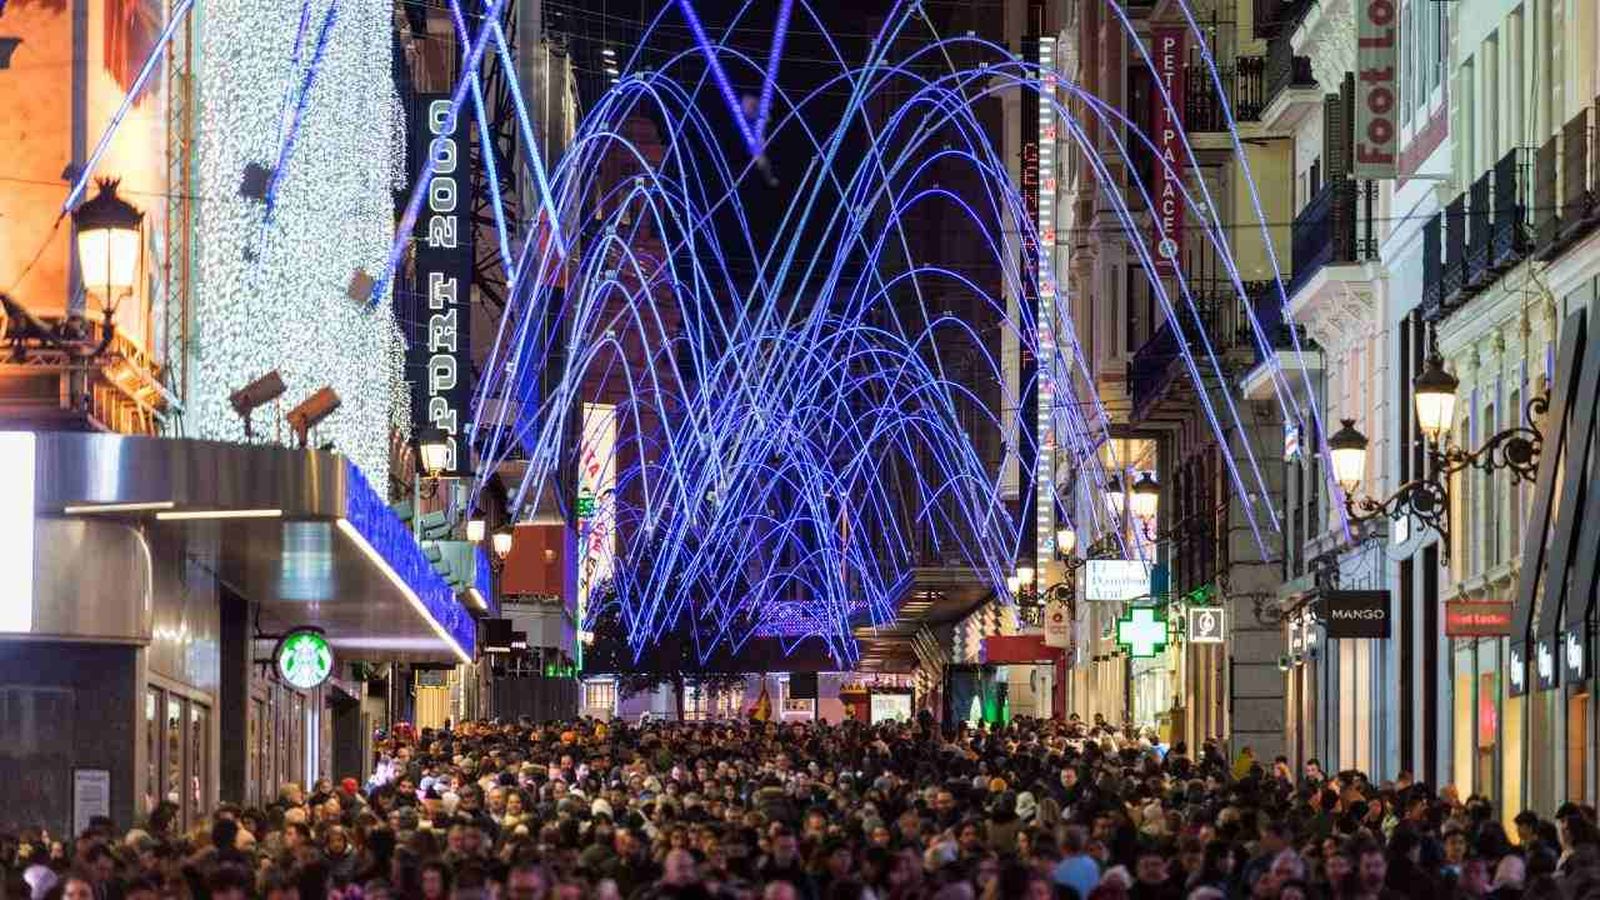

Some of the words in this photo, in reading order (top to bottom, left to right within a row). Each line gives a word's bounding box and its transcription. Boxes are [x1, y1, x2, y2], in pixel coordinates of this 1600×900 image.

[1163, 37, 1175, 123] PETIT
[1357, 66, 1394, 164] Foot
[429, 99, 458, 248] 2000
[1162, 130, 1175, 234] PALACE
[1331, 609, 1385, 620] MANGO
